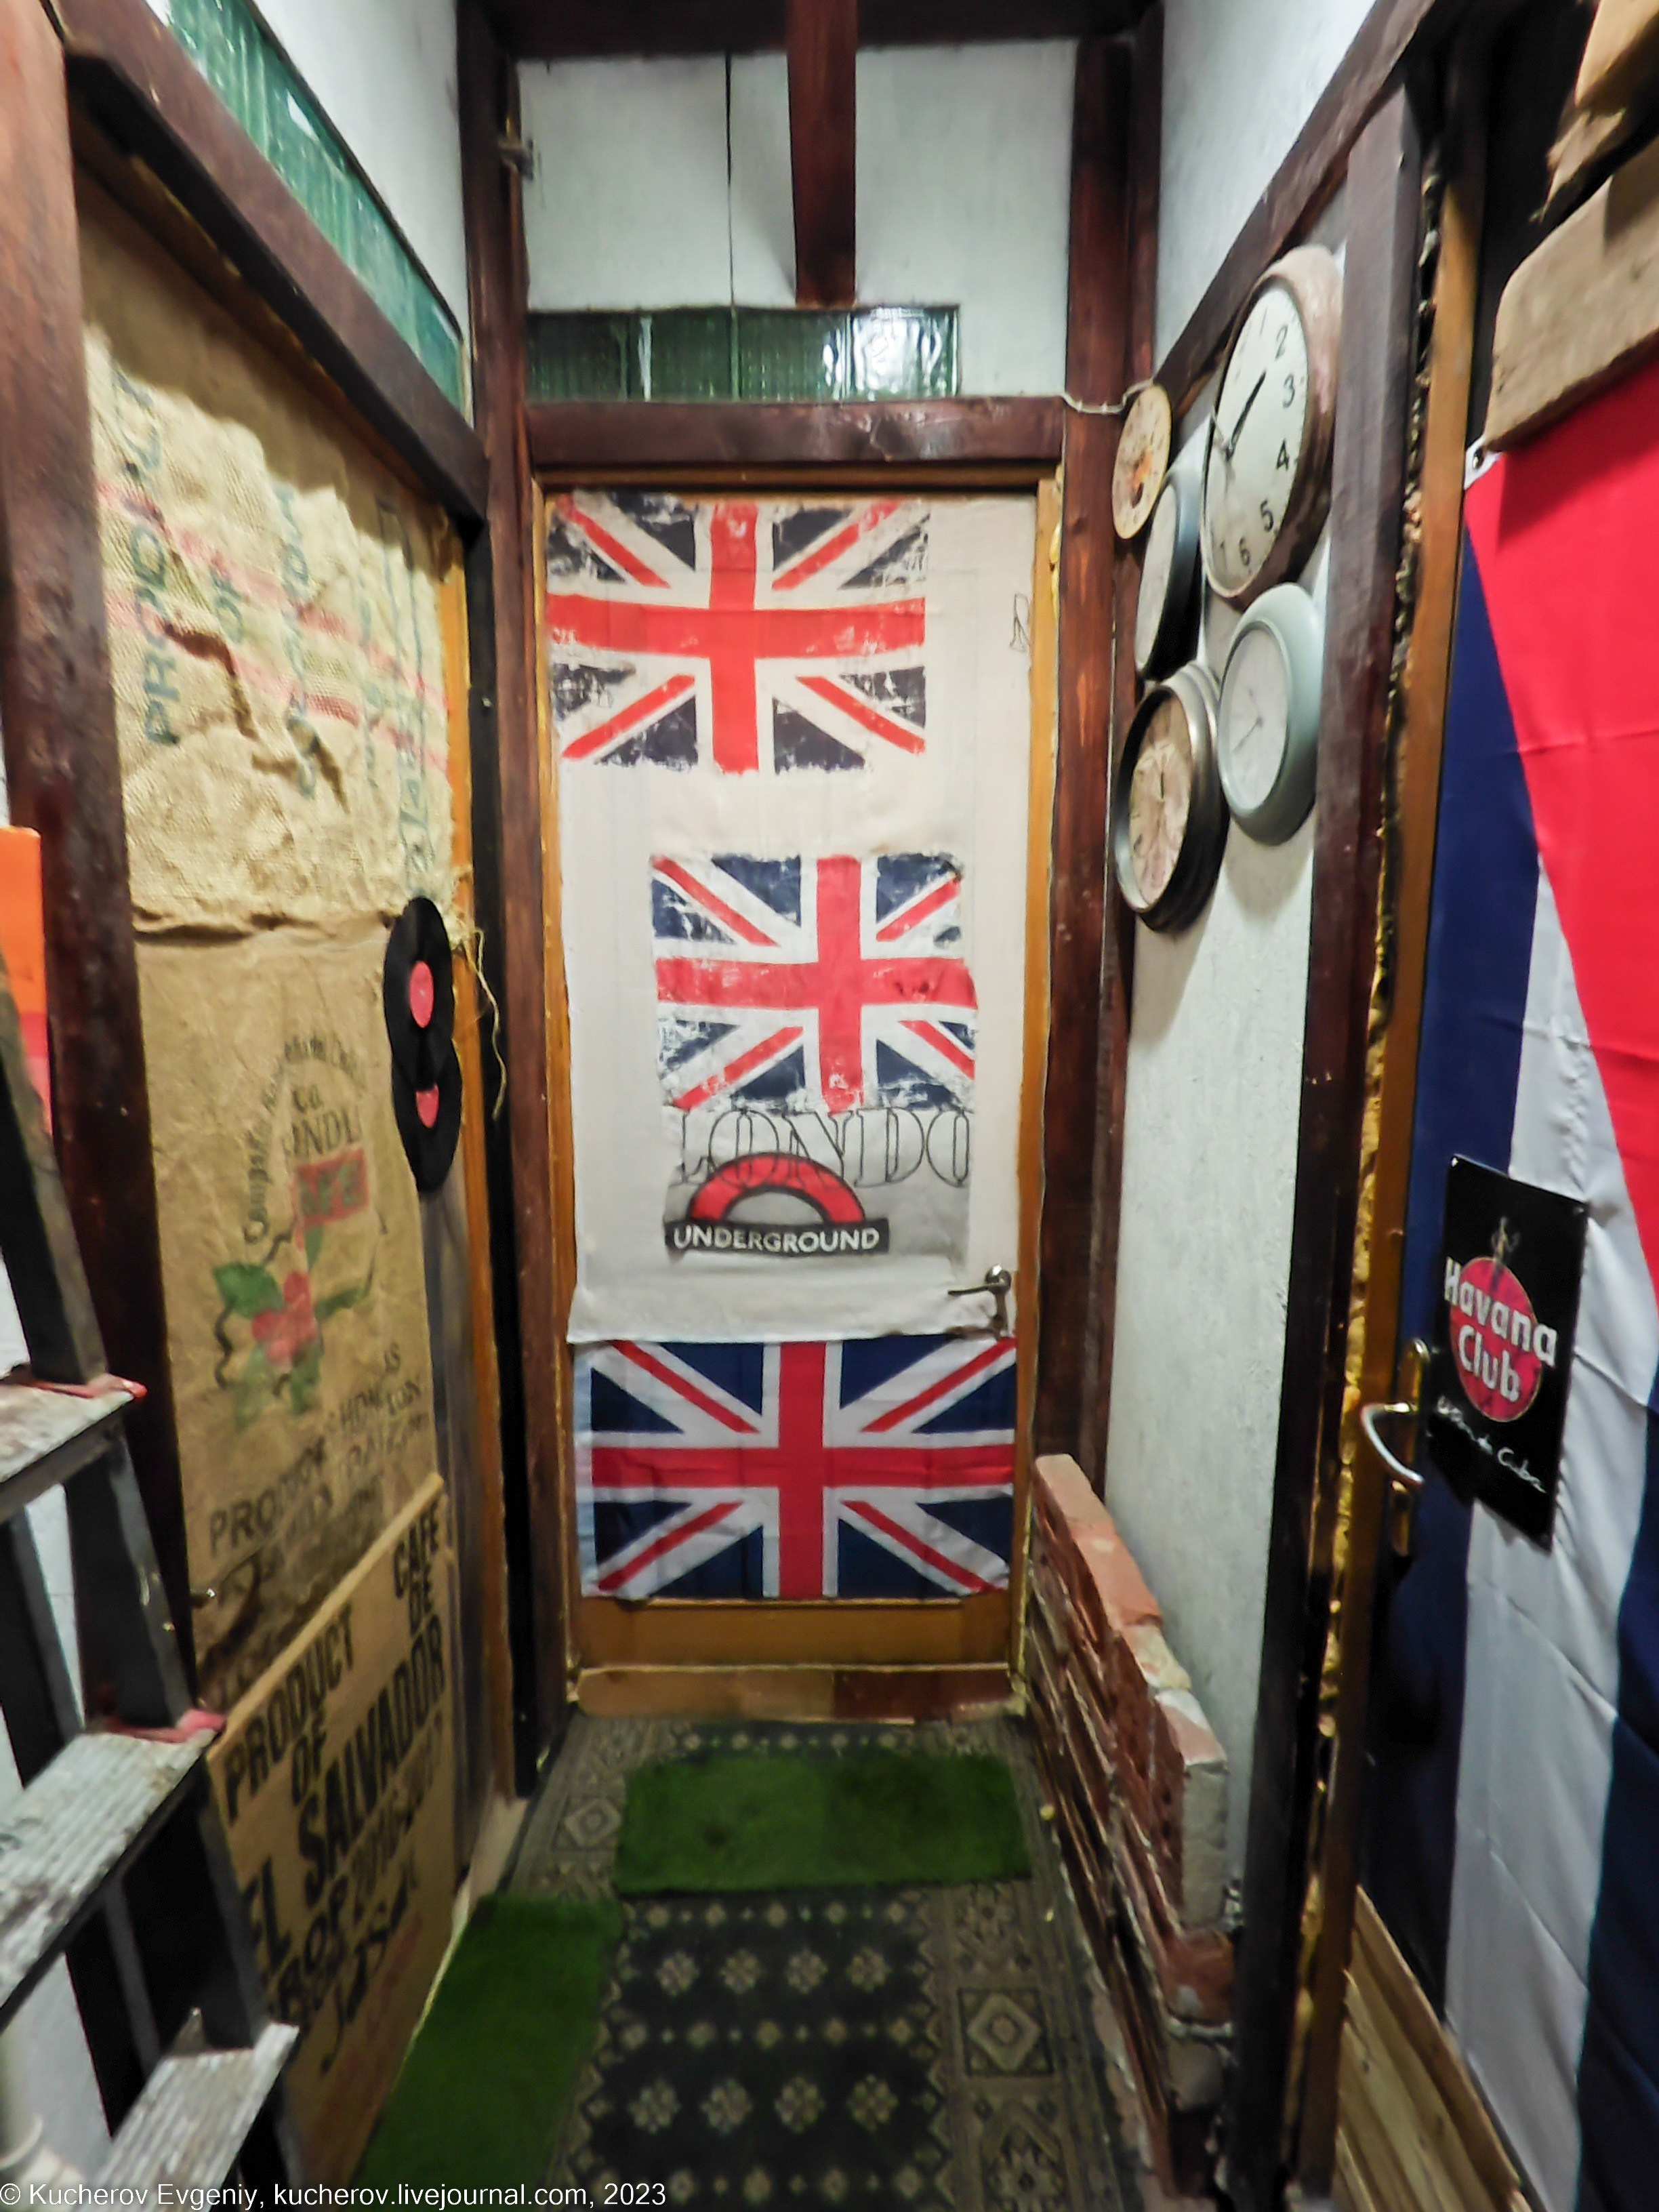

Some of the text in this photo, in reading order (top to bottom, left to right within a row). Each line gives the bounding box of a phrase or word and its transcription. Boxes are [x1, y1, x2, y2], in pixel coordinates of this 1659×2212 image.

[1282, 373, 1295, 409] 3
[1276, 437, 1290, 471] 4
[1260, 499, 1273, 532] 5
[668, 1107, 975, 1189] LONDO
[674, 1223, 880, 1253] UNDERGROUND
[1444, 1255, 1557, 1368] Havana
[1458, 1325, 1521, 1402] Club
[224, 1603, 354, 1828] PRODUCT
[291, 1704, 327, 1807] OF
[298, 1613, 446, 1908] SALVADOR
